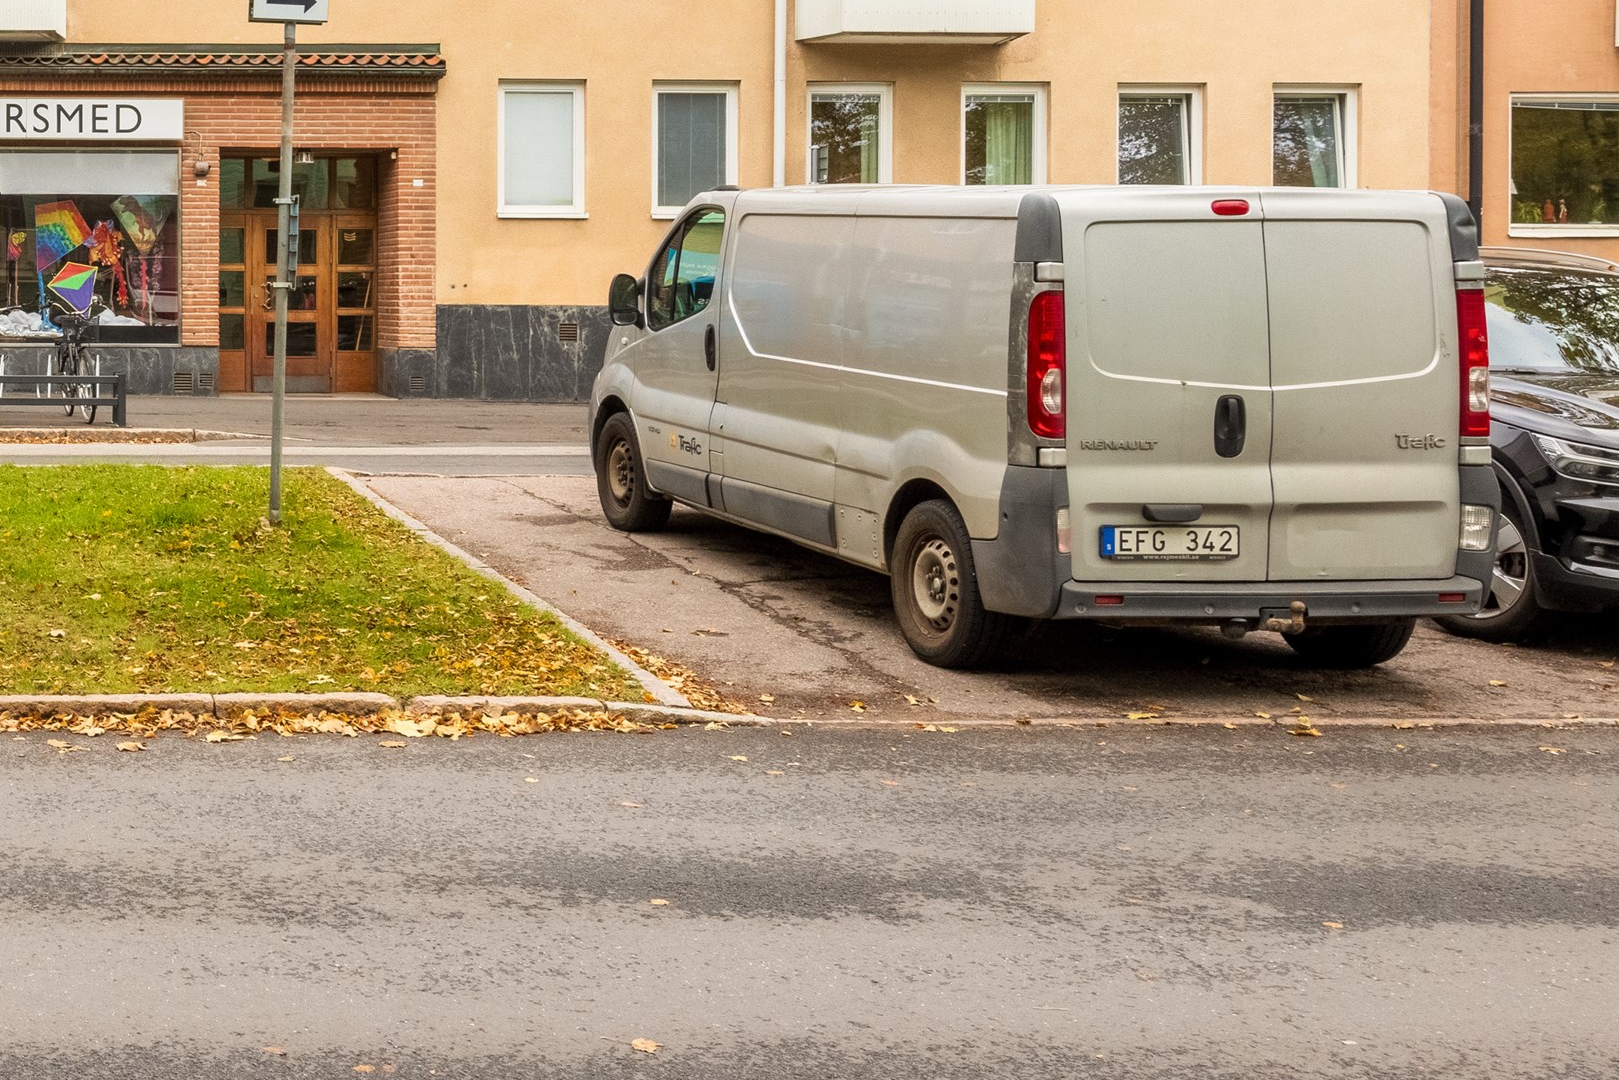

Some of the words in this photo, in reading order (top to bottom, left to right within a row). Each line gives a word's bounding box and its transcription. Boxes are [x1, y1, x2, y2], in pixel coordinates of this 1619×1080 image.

[678, 434, 702, 455] Trafic
[1081, 439, 1158, 451] RENAULT
[1394, 432, 1446, 451] Trafic
[1119, 530, 1166, 552] EFG
[1186, 530, 1233, 552] 342
